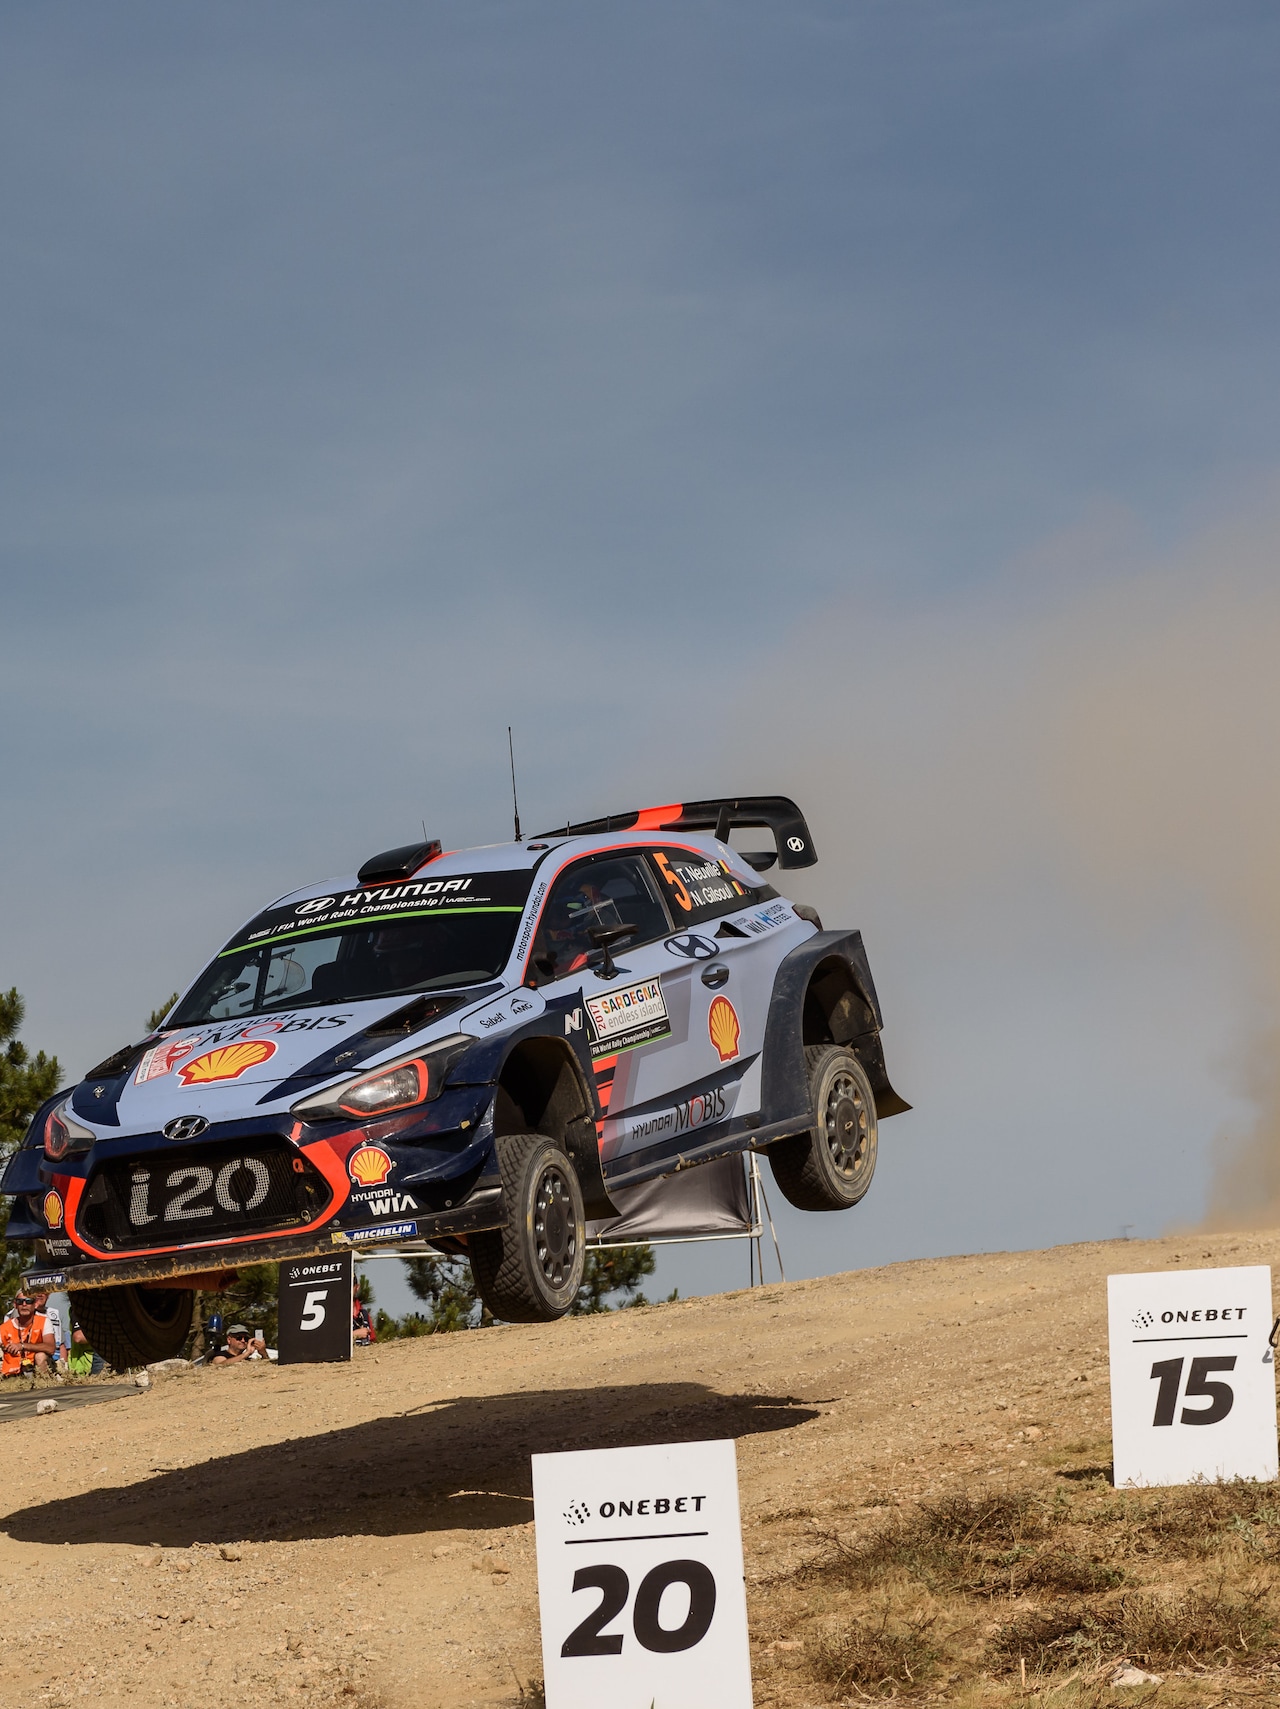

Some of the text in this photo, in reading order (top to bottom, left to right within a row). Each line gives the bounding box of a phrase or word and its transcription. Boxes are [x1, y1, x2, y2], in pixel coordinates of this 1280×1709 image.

[652, 852, 692, 911] 5
[676, 862, 721, 883] T. Neuville
[339, 878, 472, 907] HYUNDAI
[690, 883, 734, 906] N. Gilsoul
[277, 922, 295, 932] FIA
[298, 913, 328, 926] World
[330, 909, 358, 919] Rally
[360, 898, 438, 914] Championship
[516, 882, 547, 961] motorsport.hyundai.com
[512, 1003, 533, 1015] AMG
[601, 984, 659, 1014] SARDEGNA
[608, 998, 663, 1028] endless island
[186, 1013, 297, 1038] HYUNDAI
[195, 1014, 354, 1047] MOBIS
[480, 1012, 507, 1029] Sabelt
[590, 1003, 607, 1031] 2017
[600, 1042, 612, 1053] World
[611, 1039, 622, 1049] Rally
[622, 1029, 650, 1045] Championship
[632, 1086, 725, 1140] HYUNDAI MOBIS
[129, 1157, 270, 1226] i20
[351, 1188, 394, 1202] HYUNDAI
[353, 1225, 413, 1240] MICHELIN
[302, 1263, 342, 1275] ONEBET
[300, 1290, 328, 1331] 5
[1161, 1308, 1247, 1324] ONEBET
[1150, 1355, 1237, 1427] 15
[599, 1496, 706, 1518] ONEBET
[560, 1559, 717, 1658] 20
